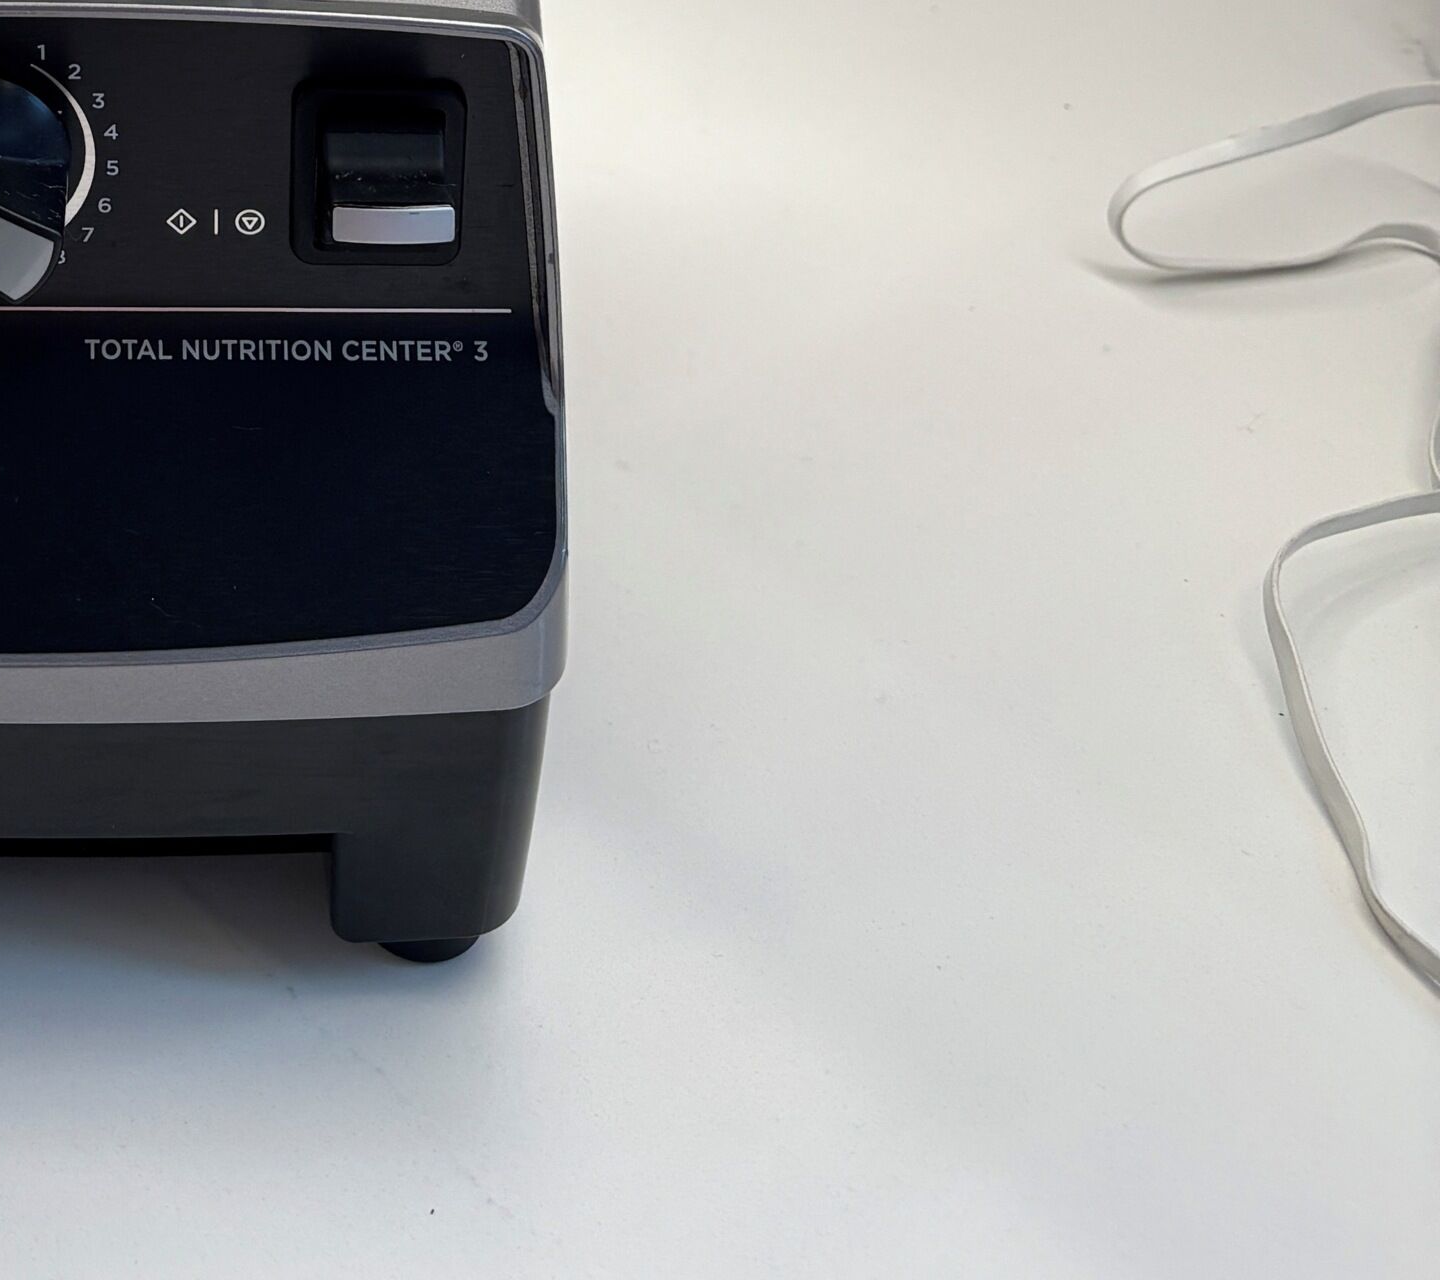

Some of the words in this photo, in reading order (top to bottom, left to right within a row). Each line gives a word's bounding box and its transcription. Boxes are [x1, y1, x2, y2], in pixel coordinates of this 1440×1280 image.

[37, 44, 46, 60] 1
[68, 63, 81, 80] 2
[92, 93, 105, 109] 3
[104, 124, 119, 140] 4
[106, 160, 119, 176] 5
[98, 198, 112, 213] 6
[81, 227, 95, 242] 7
[83, 338, 173, 361] TOTAL
[181, 339, 332, 361] NUTRITION
[473, 340, 489, 362] 3
